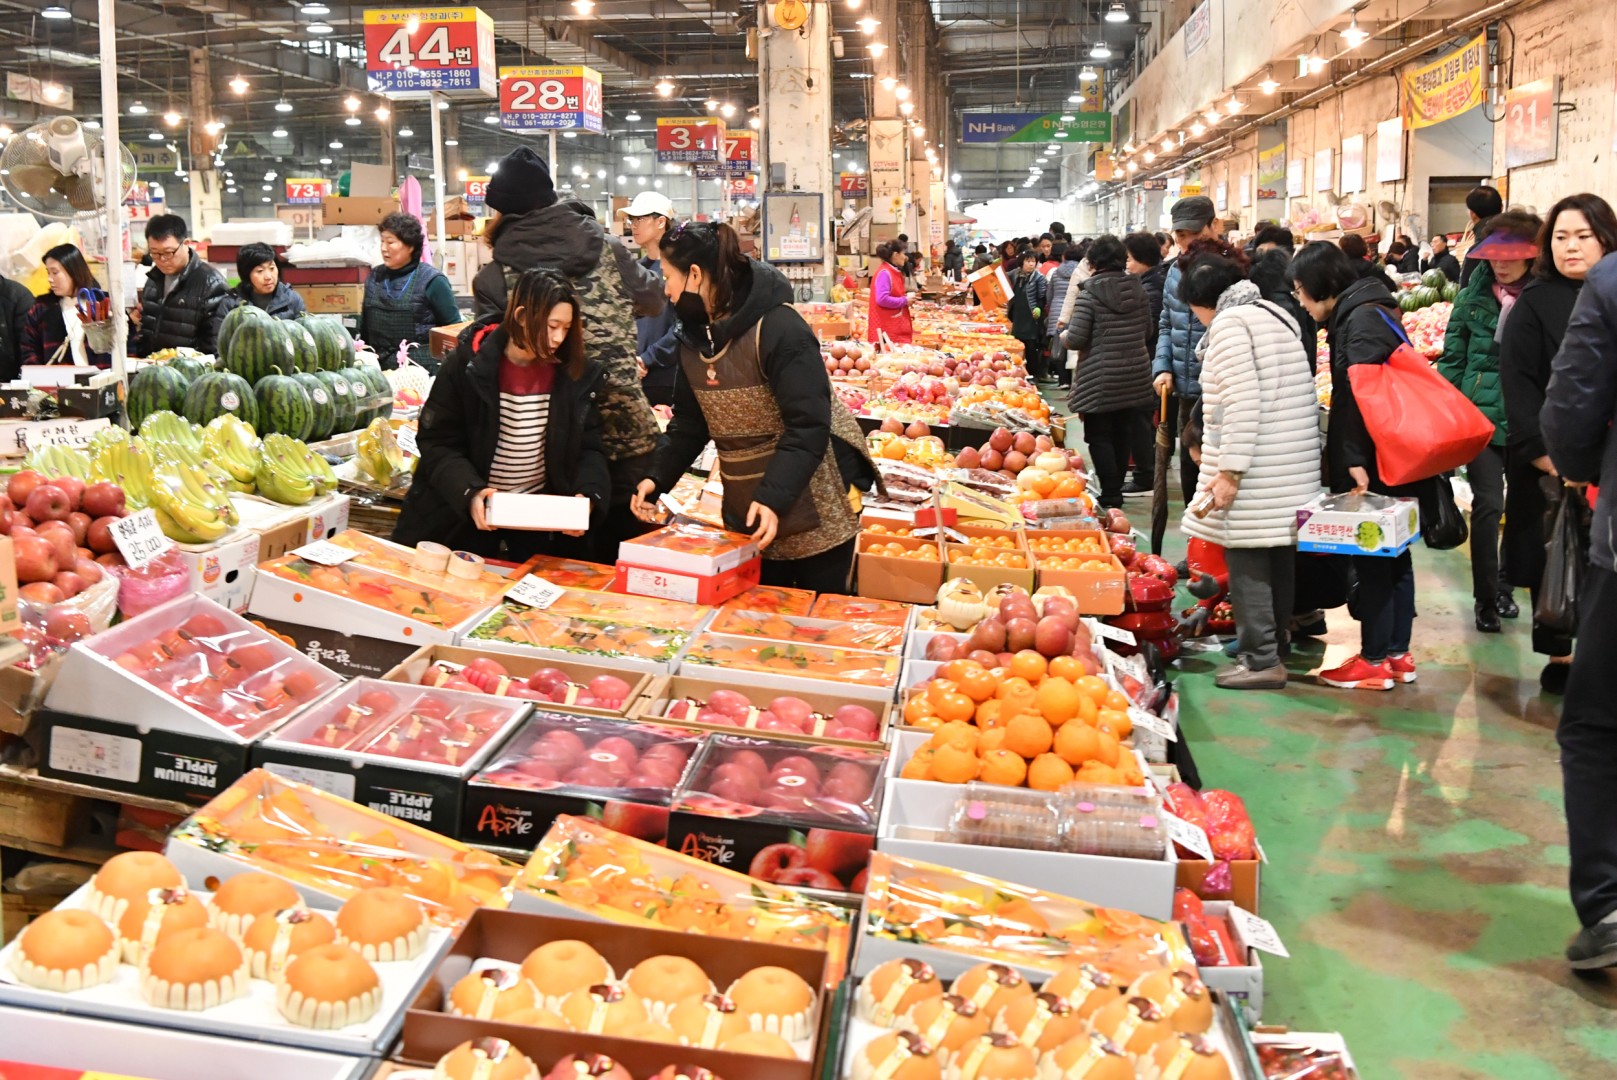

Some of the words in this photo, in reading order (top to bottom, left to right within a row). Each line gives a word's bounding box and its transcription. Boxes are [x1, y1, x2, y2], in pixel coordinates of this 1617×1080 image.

[968, 122, 996, 133] NH
[997, 123, 1016, 133] Bank
[174, 757, 219, 775] APPLE
[154, 766, 217, 789] PREMIUM
[389, 791, 434, 808] APPLE
[368, 801, 433, 822] PREMIUM
